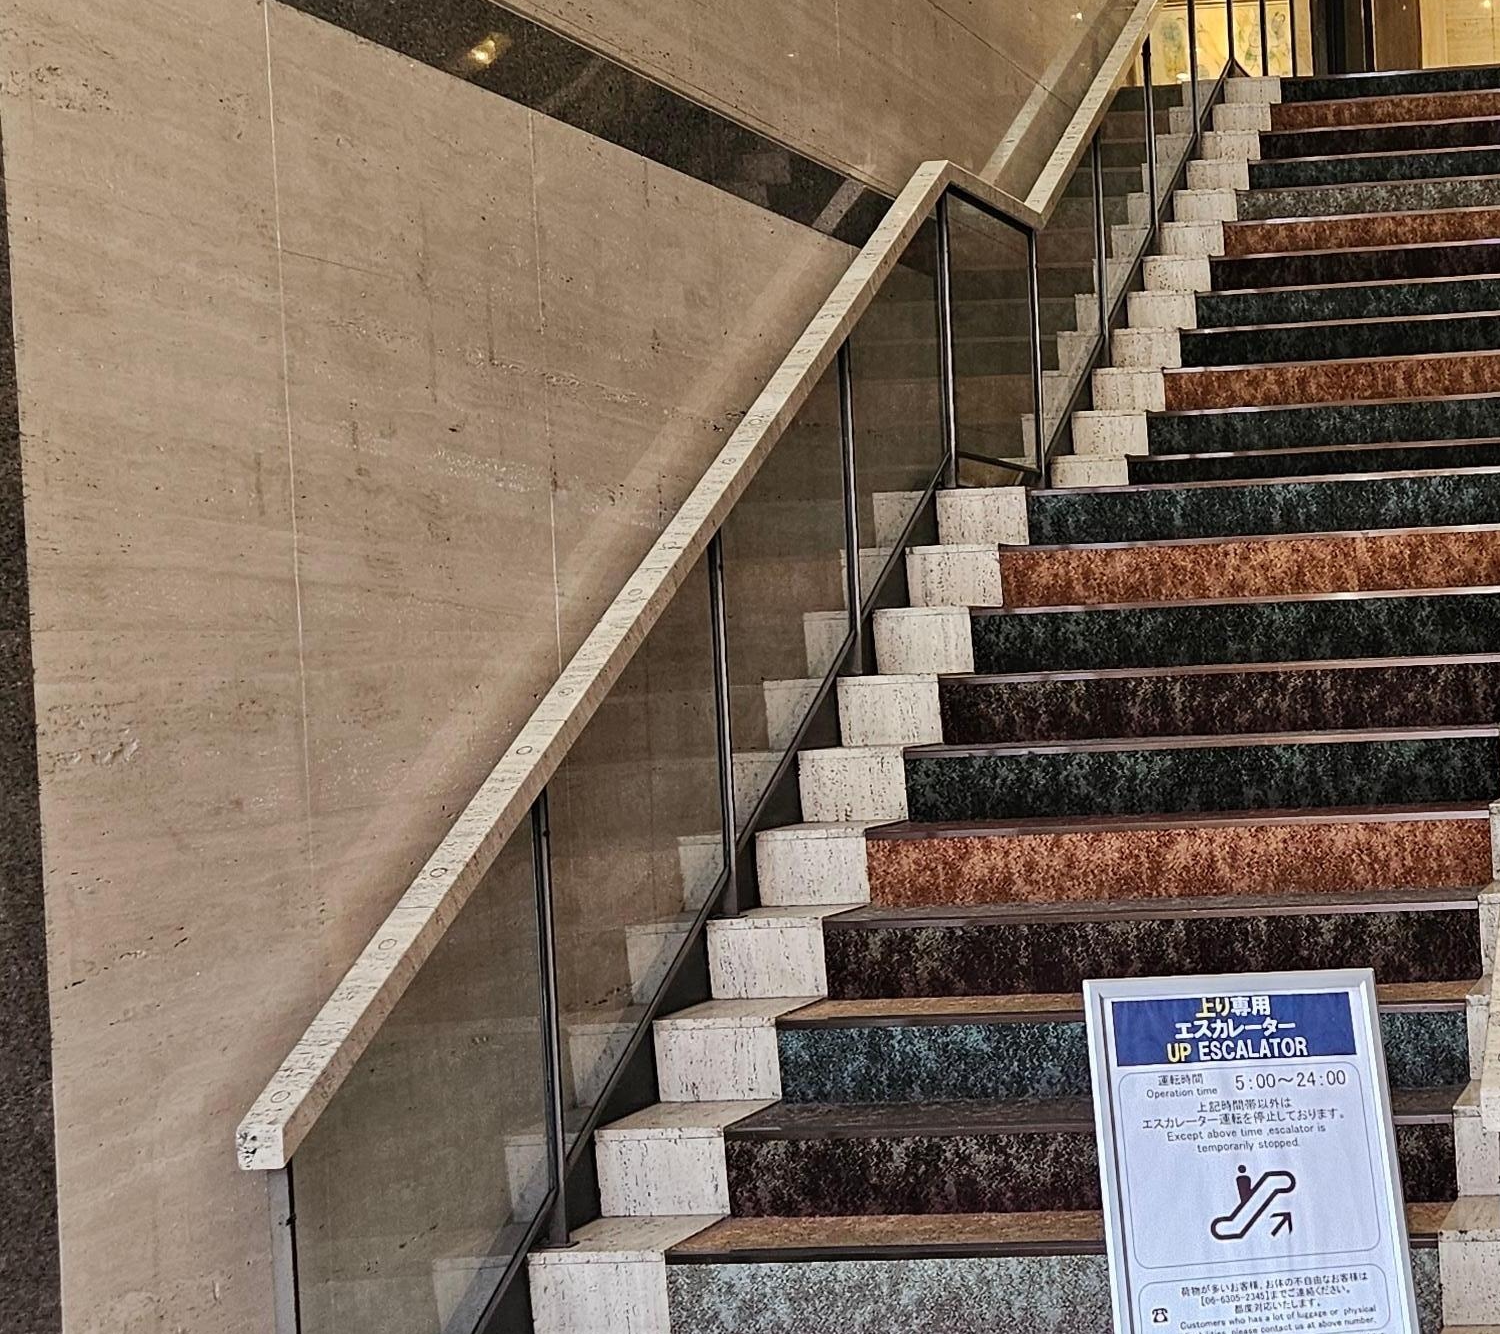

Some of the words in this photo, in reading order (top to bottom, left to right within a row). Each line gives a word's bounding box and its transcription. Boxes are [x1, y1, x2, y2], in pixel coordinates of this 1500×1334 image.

[1196, 996, 1271, 1017] 上り専用
[1175, 1018, 1296, 1039] エスカレーター
[1166, 1042, 1192, 1062] UP
[1199, 1037, 1308, 1061] ESCALATOR
[1158, 1073, 1203, 1086] 運転時間
[1146, 1089, 1194, 1099] Operation
[1196, 1087, 1218, 1096] time
[1197, 1097, 1292, 1113] 上記時間帯以外は
[1142, 1108, 1344, 1129] エスカレーター運転を停止しております。
[1166, 1131, 1203, 1142] Except
[1207, 1129, 1237, 1139] above
[1240, 1128, 1263, 1137] time
[1317, 1123, 1326, 1132] is
[1197, 1140, 1254, 1153] temporarily
[1180, 1318, 1226, 1330] Customers
[1229, 1317, 1246, 1326] who
[1248, 1315, 1263, 1323] has
[1272, 1312, 1284, 1321] lot
[1286, 1311, 1295, 1320] of
[1343, 1304, 1377, 1316] physical
[1261, 1323, 1292, 1333] contact
[1318, 1319, 1342, 1328] above
